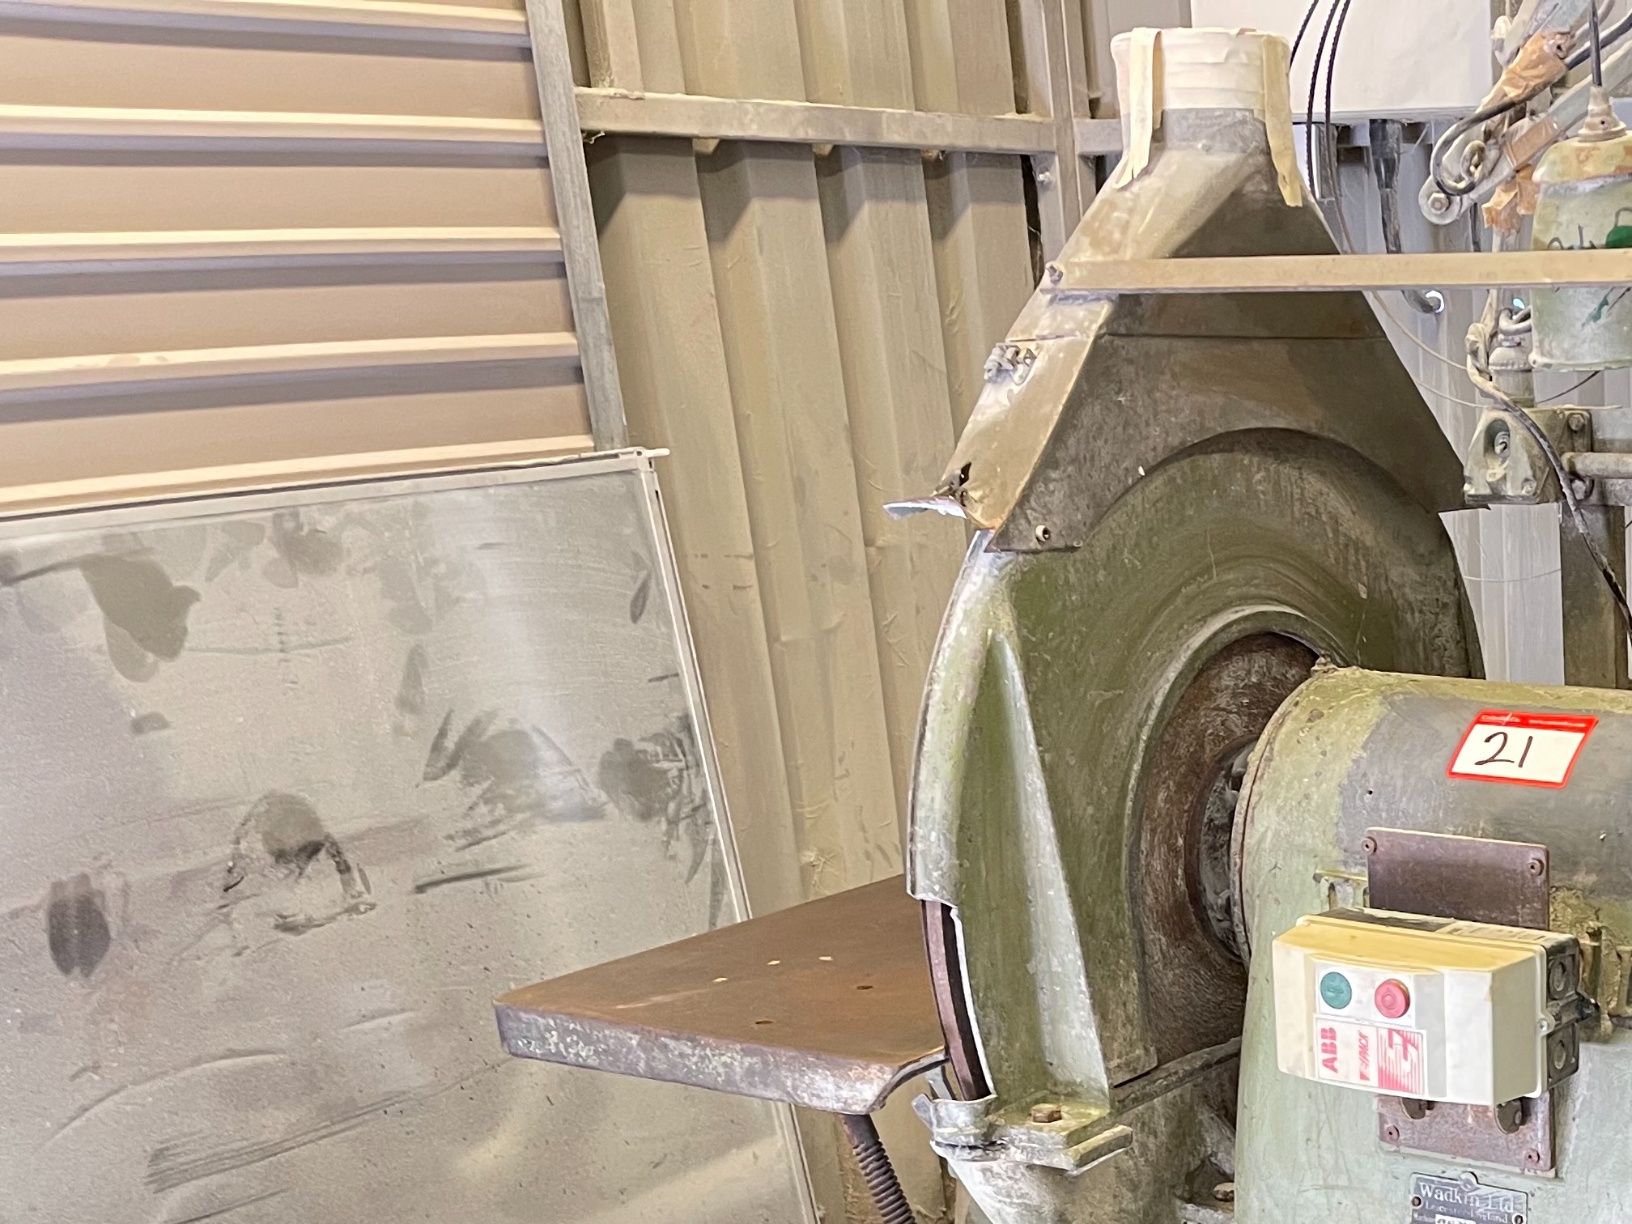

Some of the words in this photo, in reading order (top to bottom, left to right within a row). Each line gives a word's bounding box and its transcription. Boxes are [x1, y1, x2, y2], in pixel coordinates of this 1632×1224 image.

[1474, 731, 1533, 768] 21
[1321, 1027, 1338, 1073] ABB
[1419, 1182, 1481, 1208] Wadkin
